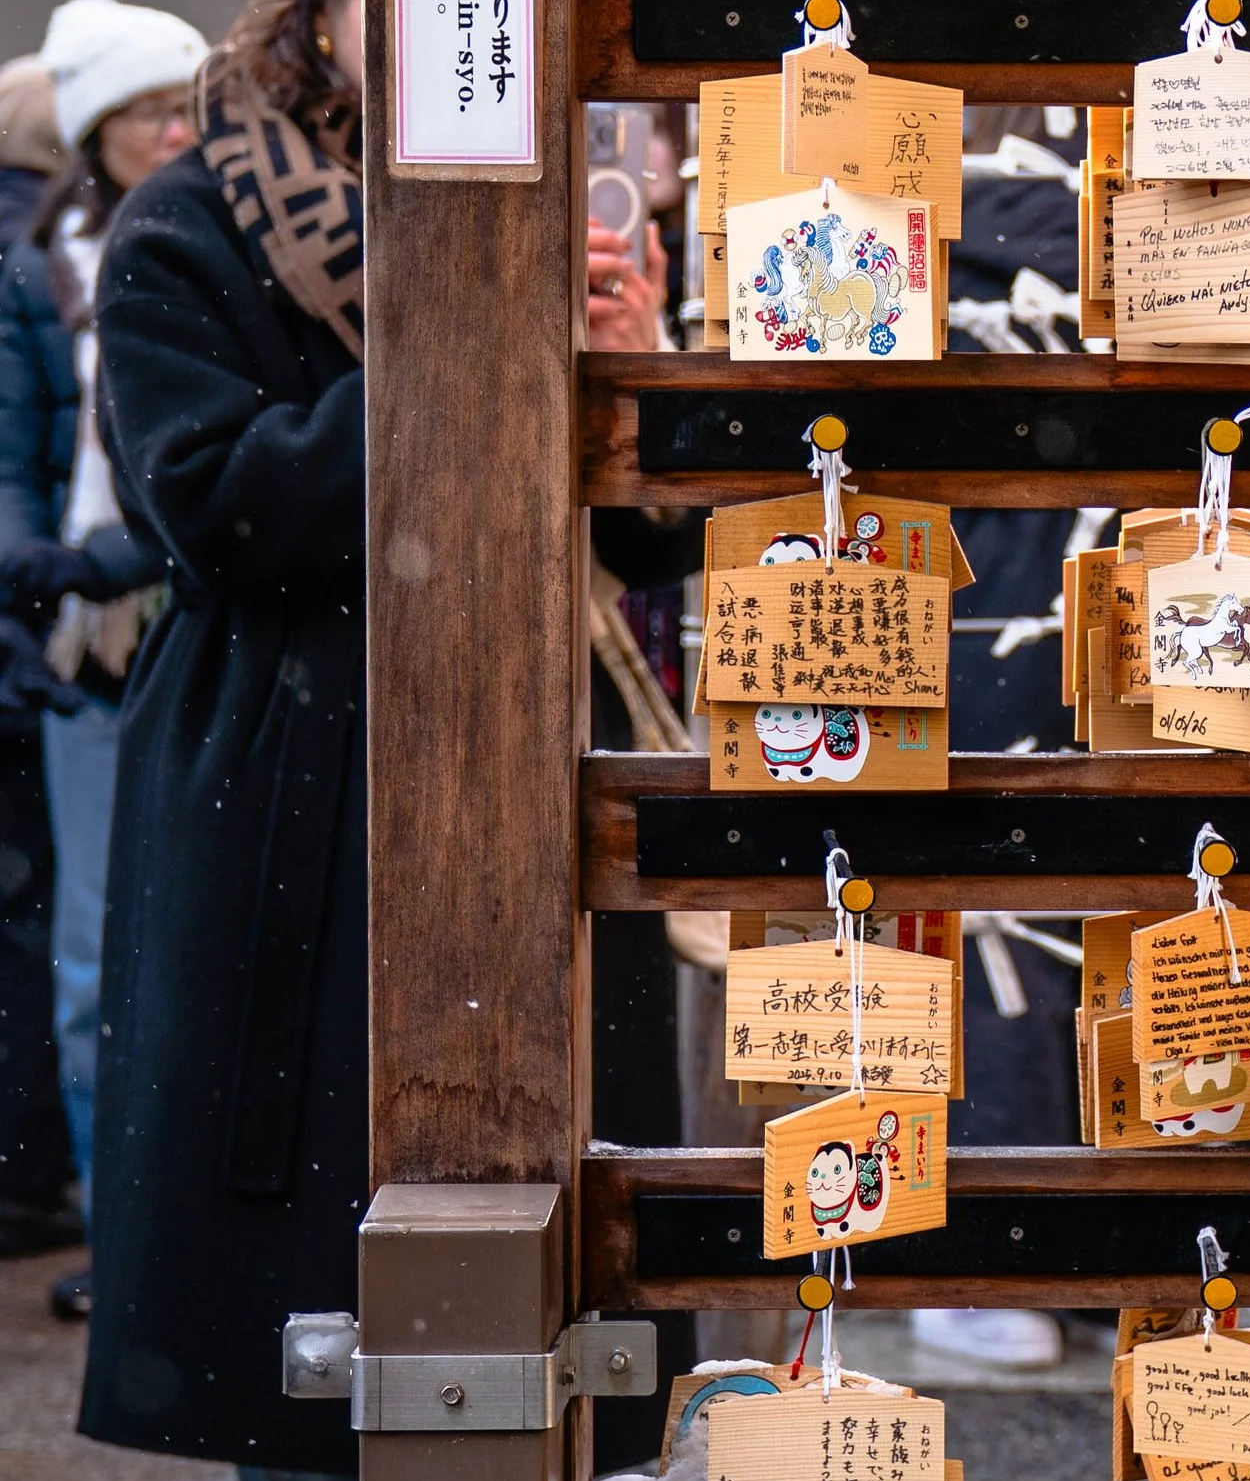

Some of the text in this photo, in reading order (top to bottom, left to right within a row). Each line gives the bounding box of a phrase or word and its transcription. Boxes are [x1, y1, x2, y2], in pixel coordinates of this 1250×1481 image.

[736, 282, 748, 344] 金閣寺
[923, 600, 934, 644] おねがい
[1154, 611, 1167, 673] 金閣寺
[724, 719, 739, 778] 金閣寺
[928, 984, 938, 1029] おねがい
[1112, 1077, 1126, 1136] 金閣寺
[916, 1126, 926, 1180] 寺まいり
[783, 1182, 795, 1244] 金閣寺
[921, 1425, 930, 1470] おねがい
